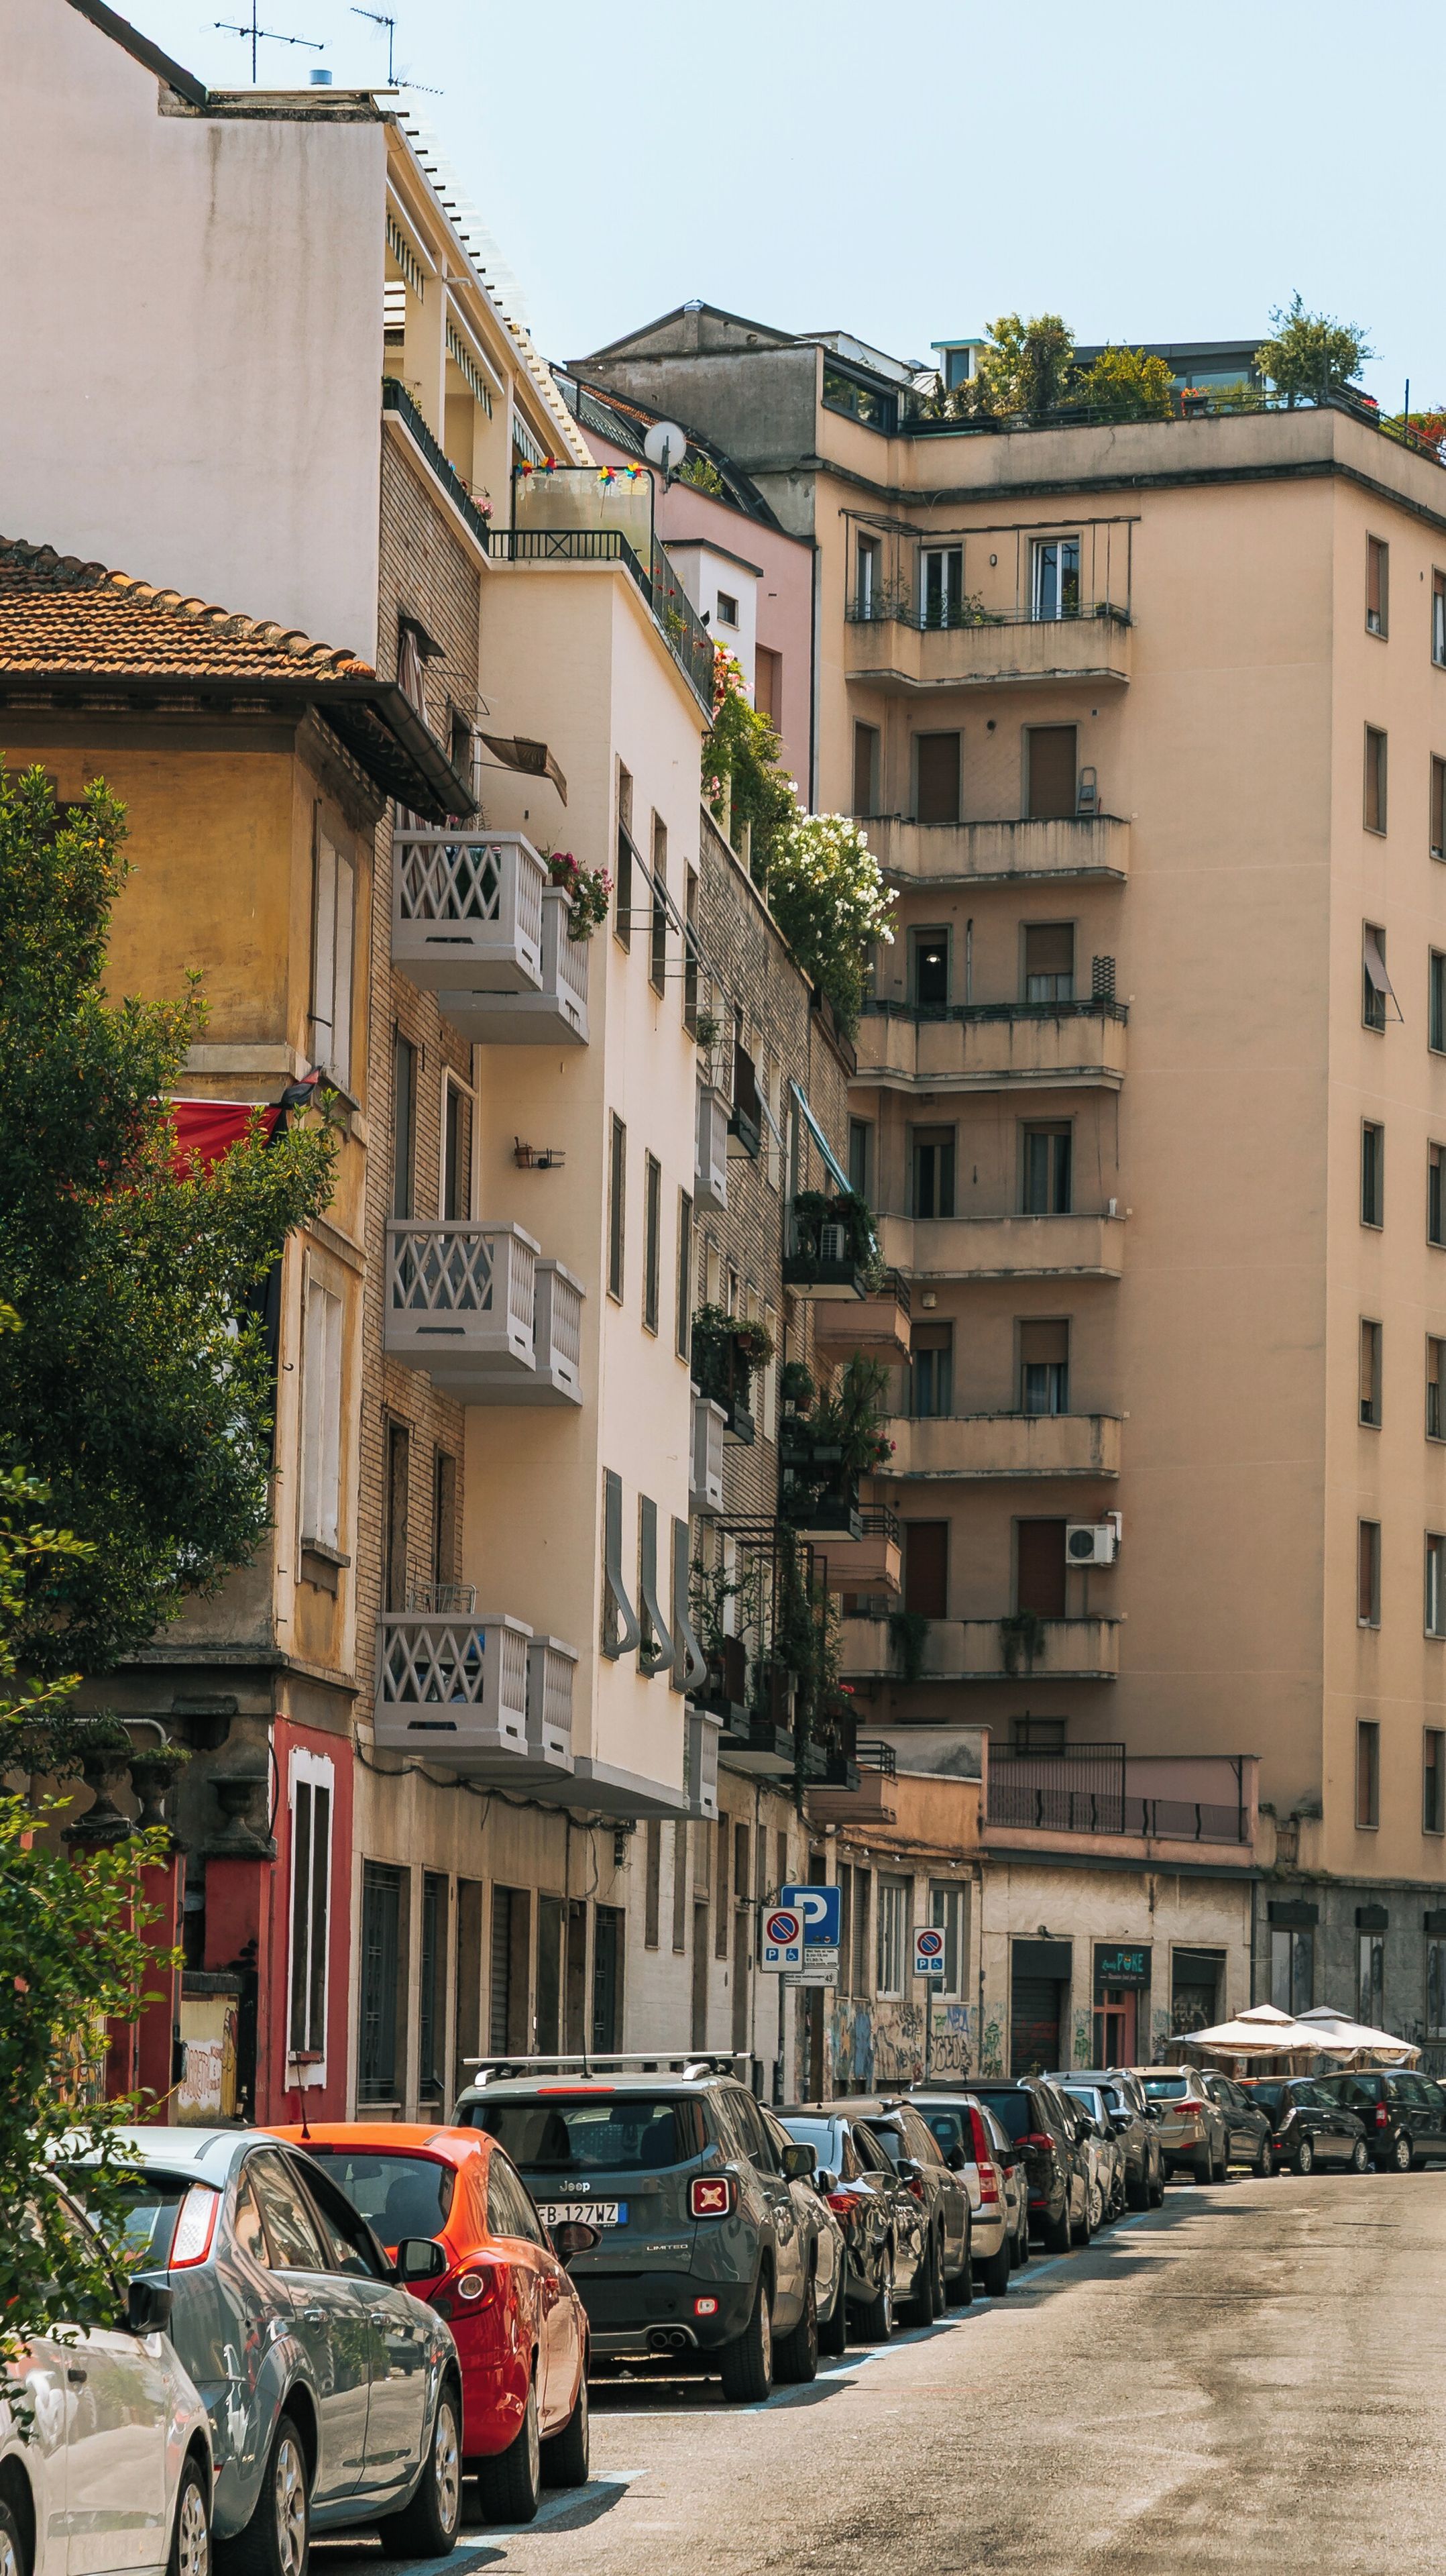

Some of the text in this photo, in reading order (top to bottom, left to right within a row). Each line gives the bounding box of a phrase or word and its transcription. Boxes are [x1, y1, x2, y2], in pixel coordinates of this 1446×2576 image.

[794, 1894, 827, 1923] P
[769, 1950, 776, 1959] P
[920, 1960, 927, 1969] P
[1117, 1953, 1144, 1972] POKE
[559, 2180, 590, 2192] Jeep
[565, 2204, 616, 2222] 127WZ
